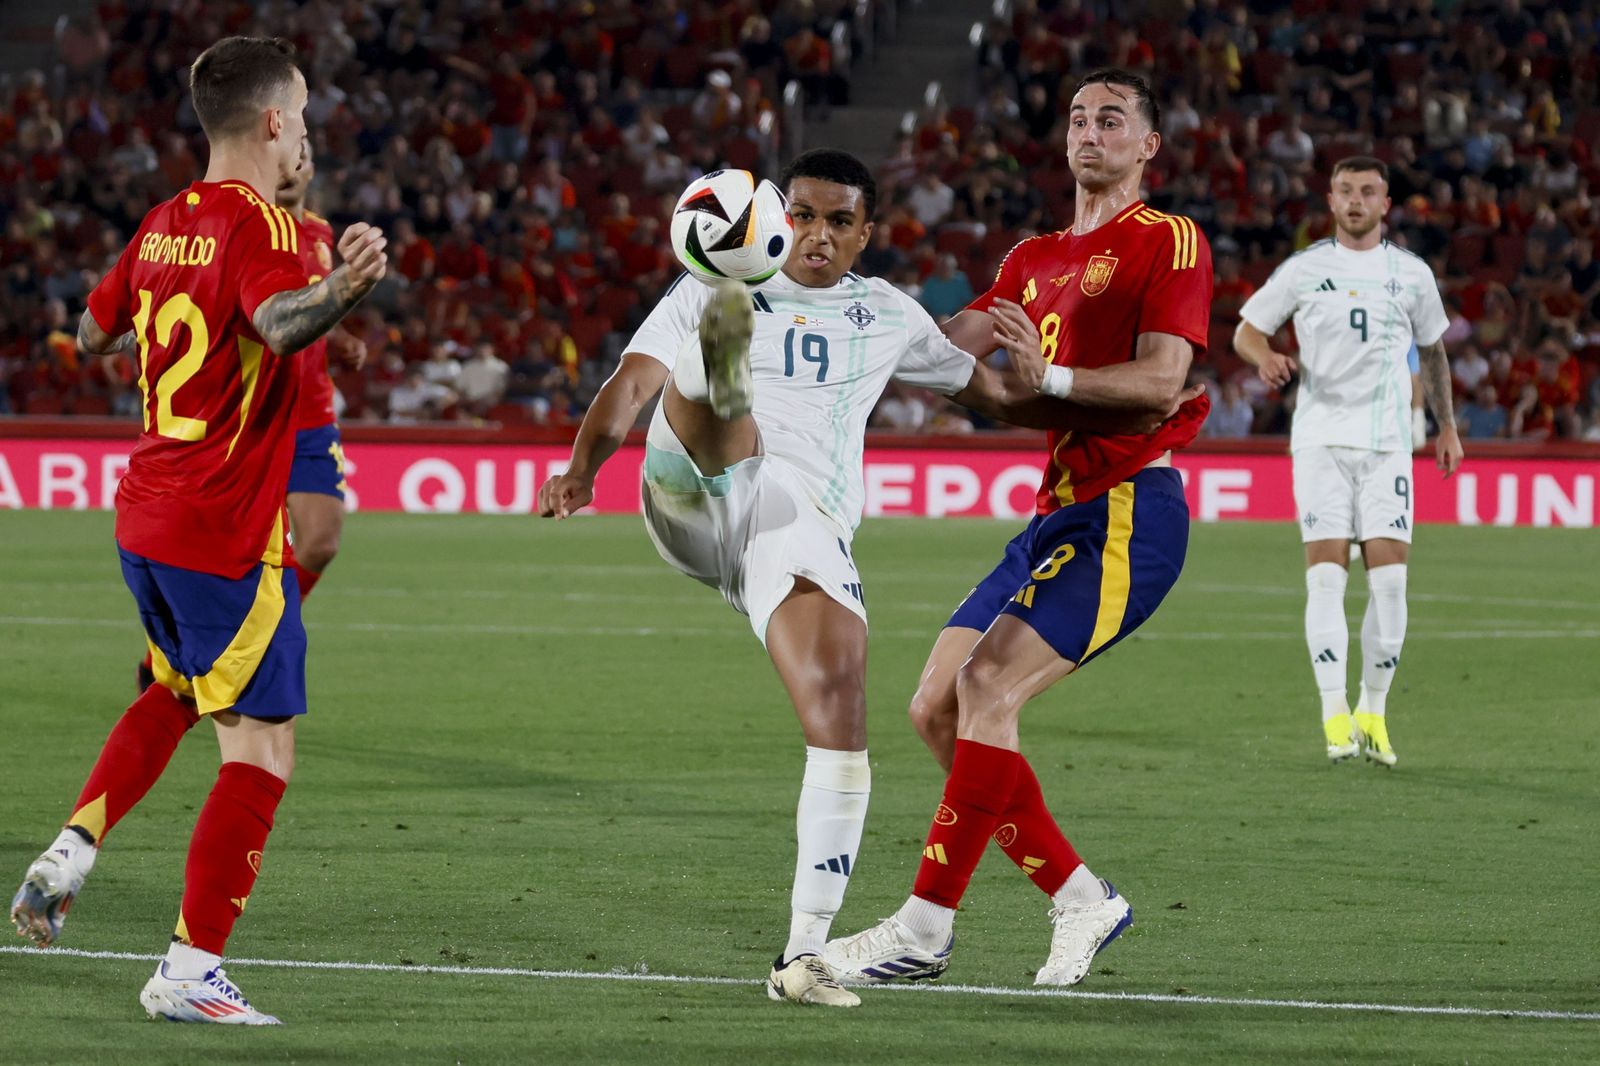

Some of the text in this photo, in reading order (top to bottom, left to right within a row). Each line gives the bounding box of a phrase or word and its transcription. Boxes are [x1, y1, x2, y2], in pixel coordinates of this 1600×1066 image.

[1040, 312, 1061, 365] 8
[1350, 307, 1367, 342] 9
[133, 288, 209, 442] 12
[784, 327, 830, 382] 19
[1395, 475, 1409, 510] 9
[1031, 543, 1076, 581] 8
